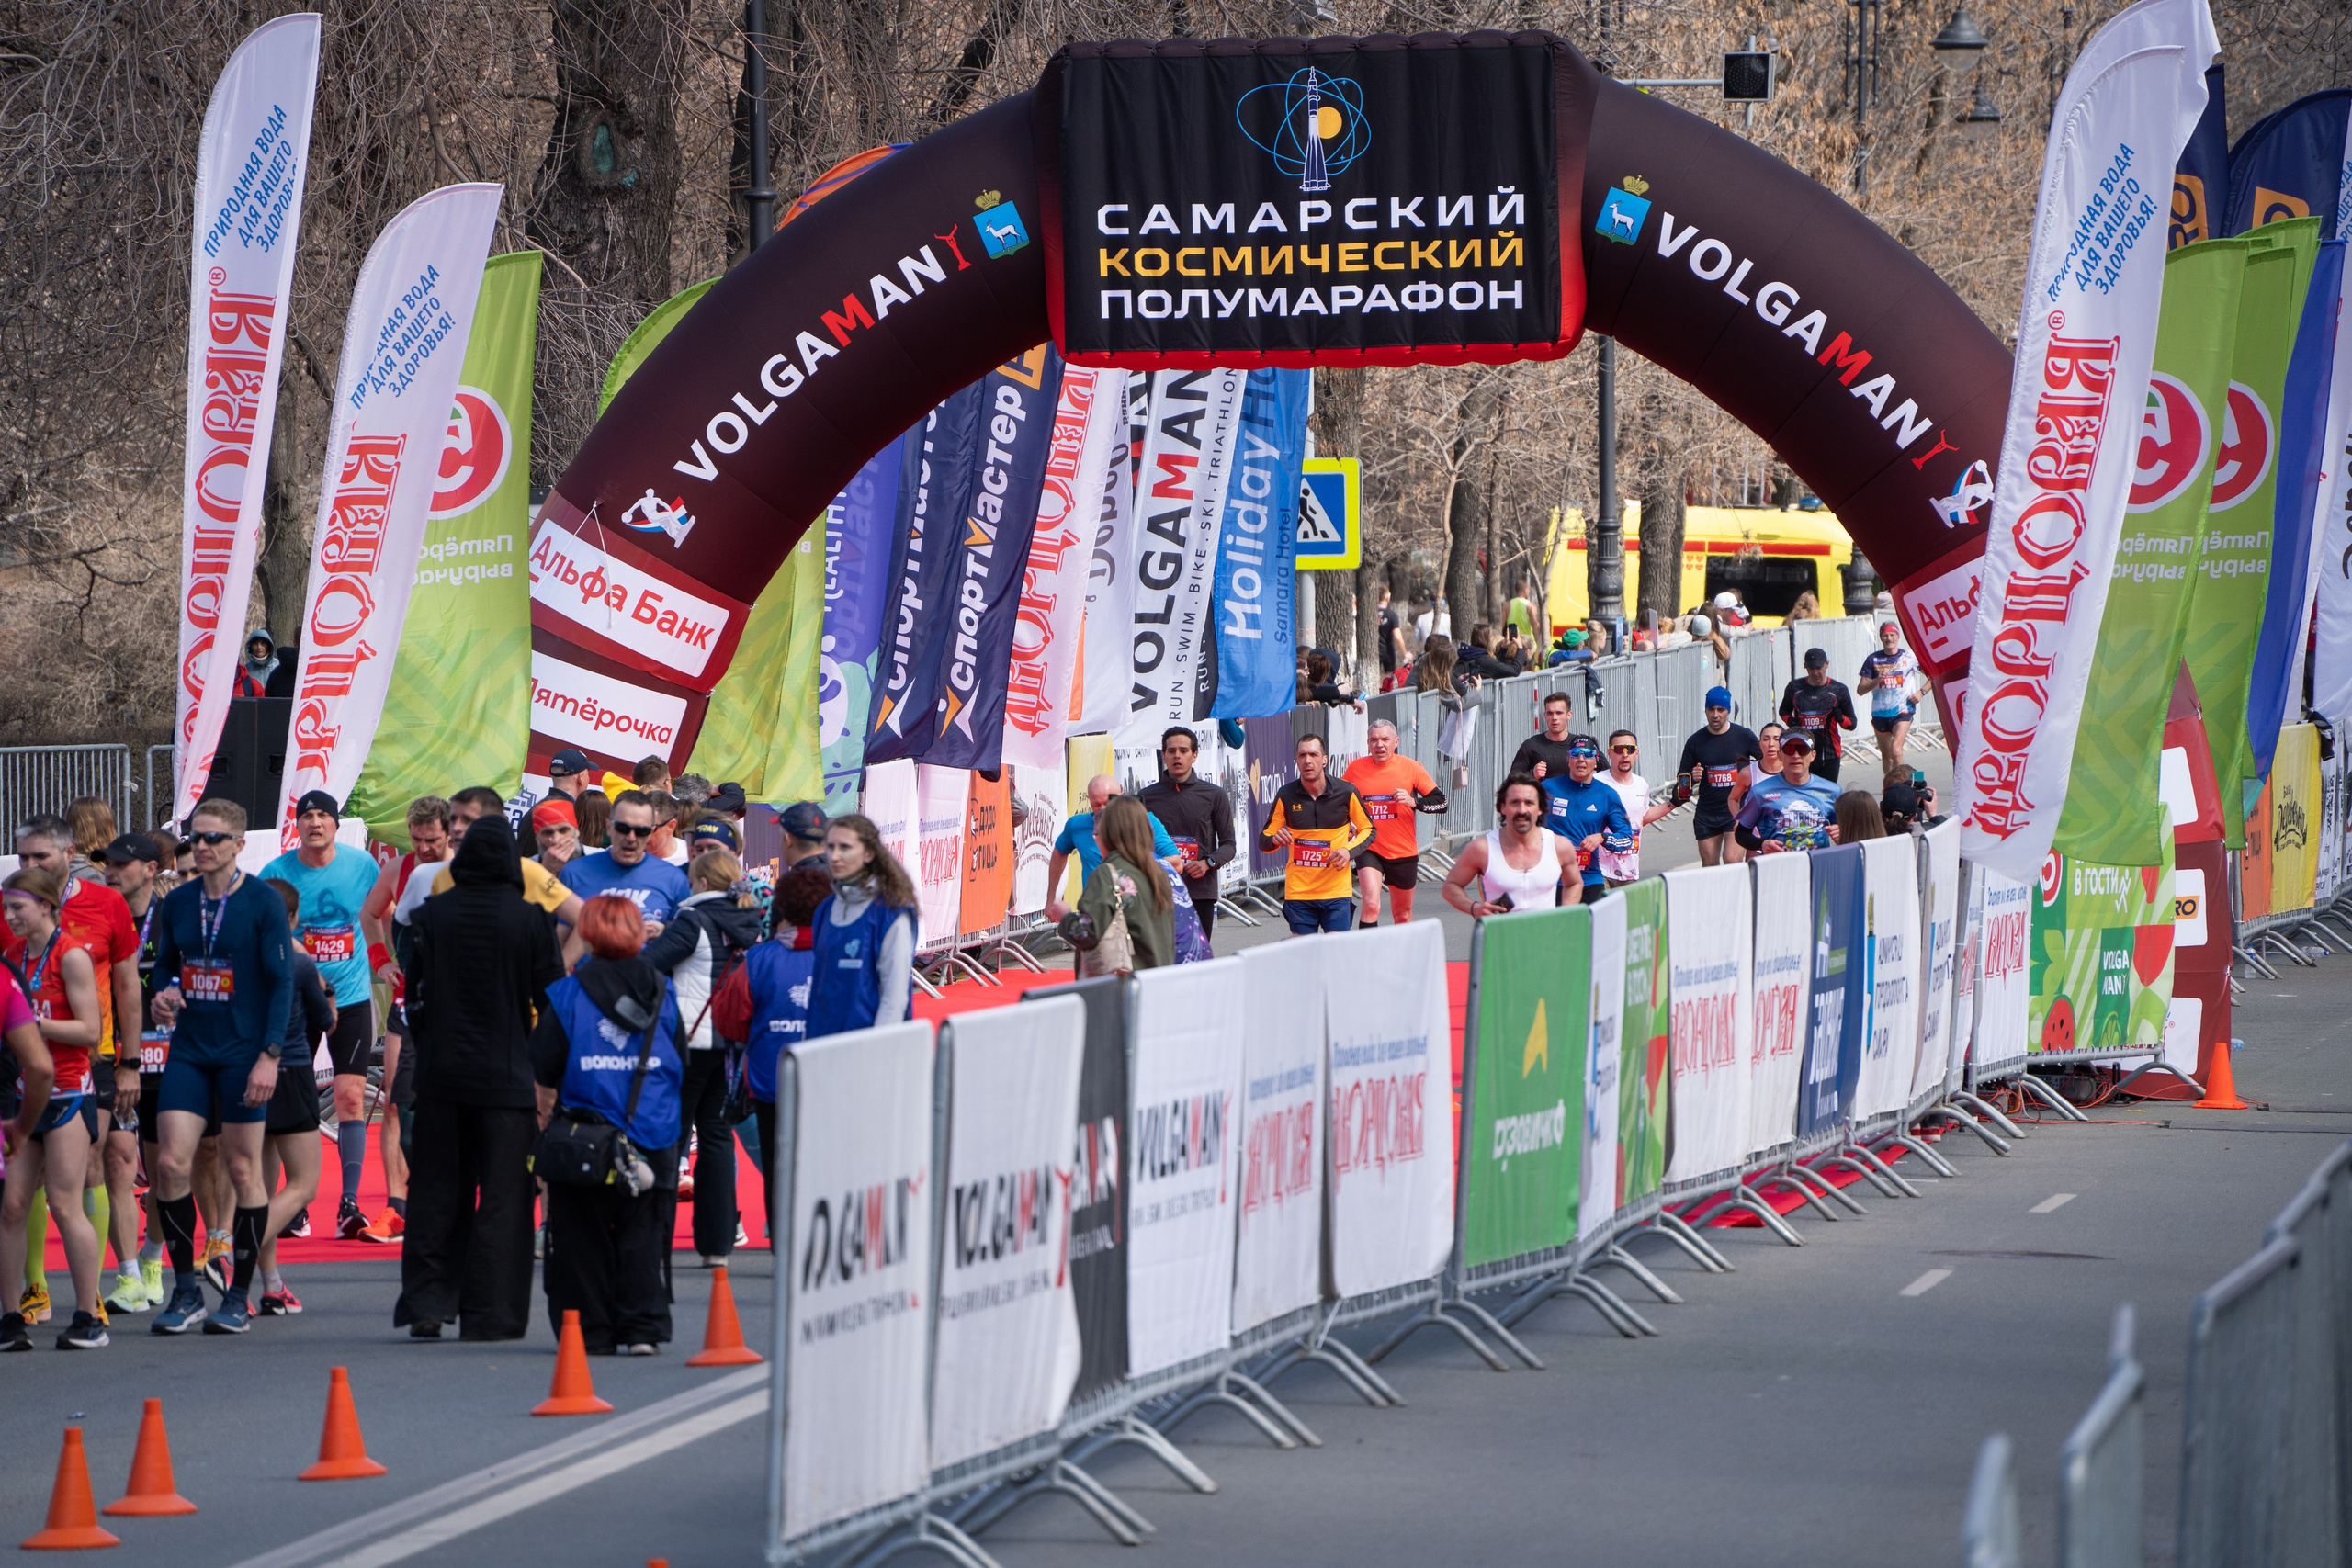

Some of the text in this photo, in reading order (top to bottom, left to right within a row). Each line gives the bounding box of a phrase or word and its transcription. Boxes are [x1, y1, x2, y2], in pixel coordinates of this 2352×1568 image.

[204, 104, 287, 258] ПРИРОДНАЯ ВОДА
[2100, 143, 2134, 195] ВОДА
[238, 140, 292, 248] ДЛЯ ВАШЕГО
[1097, 186, 1526, 236] САМАРСКИЙ
[1099, 231, 1524, 277] КОСМИЧЕСКИЙ
[2075, 177, 2141, 292] ДЛЯ ВАШЕГО
[2096, 194, 2158, 296] ЗДОРОВЬЯ!
[402, 264, 441, 310] ВОДА
[1101, 280, 1523, 320] ПОЛУМАРАФОН
[370, 297, 441, 395] ДЛЯ ВАШЕГО
[389, 311, 457, 398] ЗДОРОВЬЯ!
[1657, 211, 1933, 449] VOLGAMAN
[673, 244, 947, 482] VOLGAMAN
[1200, 497, 1216, 530] SKI
[1224, 430, 1281, 640] Holiday
[530, 534, 716, 651] Альфа Банк
[1190, 548, 1207, 593] BIKE
[1274, 507, 1291, 644] Samara Hotel
[1175, 614, 1195, 662] SWIM
[1170, 681, 1183, 720] RUN
[1714, 773, 1732, 783] 1768
[1370, 805, 1388, 815] 1712
[1301, 850, 1322, 862] 1725
[314, 939, 345, 954] 1429
[191, 974, 221, 991] 1067
[580, 1055, 662, 1072] ВОЛОНТР
